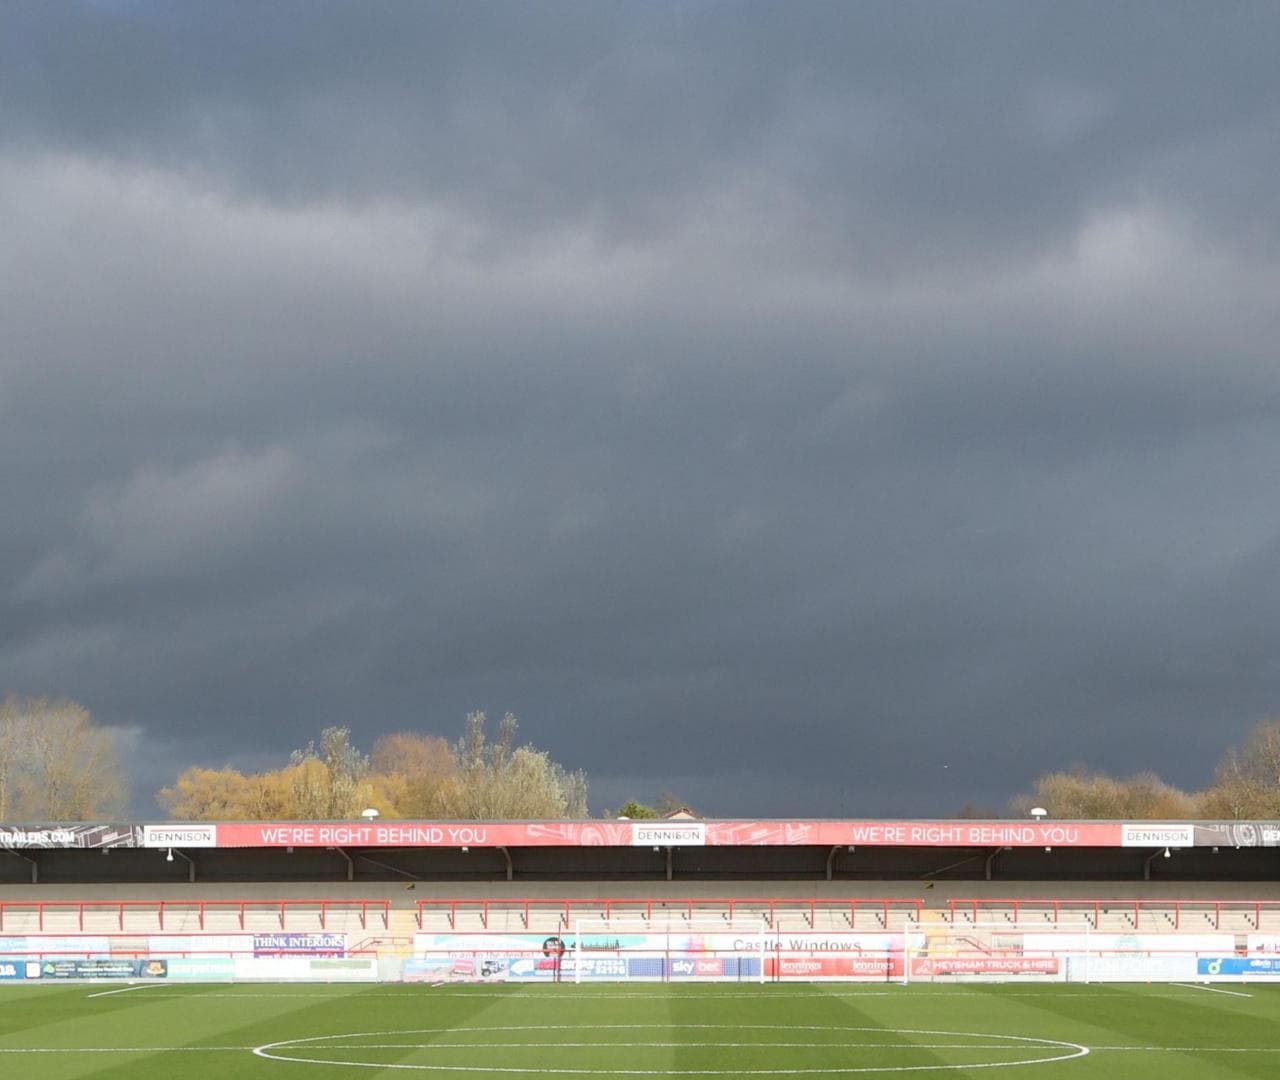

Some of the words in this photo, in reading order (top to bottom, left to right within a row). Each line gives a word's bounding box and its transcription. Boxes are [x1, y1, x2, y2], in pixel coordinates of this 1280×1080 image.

[149, 832, 211, 841] DENNISON
[261, 828, 314, 842] WE'RE
[320, 828, 371, 842] RIGHT
[377, 828, 443, 842] BEHIND
[447, 828, 486, 842] YOU
[638, 831, 700, 840] DENNISON
[853, 828, 905, 841] WE'RE
[911, 828, 961, 841] RIGHT
[969, 828, 1034, 841] BEHIND
[1039, 828, 1078, 842] YOU
[1127, 832, 1188, 841] DENNISON
[255, 936, 287, 947] THINK
[289, 936, 344, 947] INTERIORS
[733, 939, 783, 951] Castle
[789, 939, 862, 951] Windows
[672, 960, 695, 974] sky
[698, 960, 721, 972] bet
[933, 961, 984, 969] HEYSHAM
[987, 961, 1019, 969] TRUCK
[1032, 961, 1056, 969] HIRE
